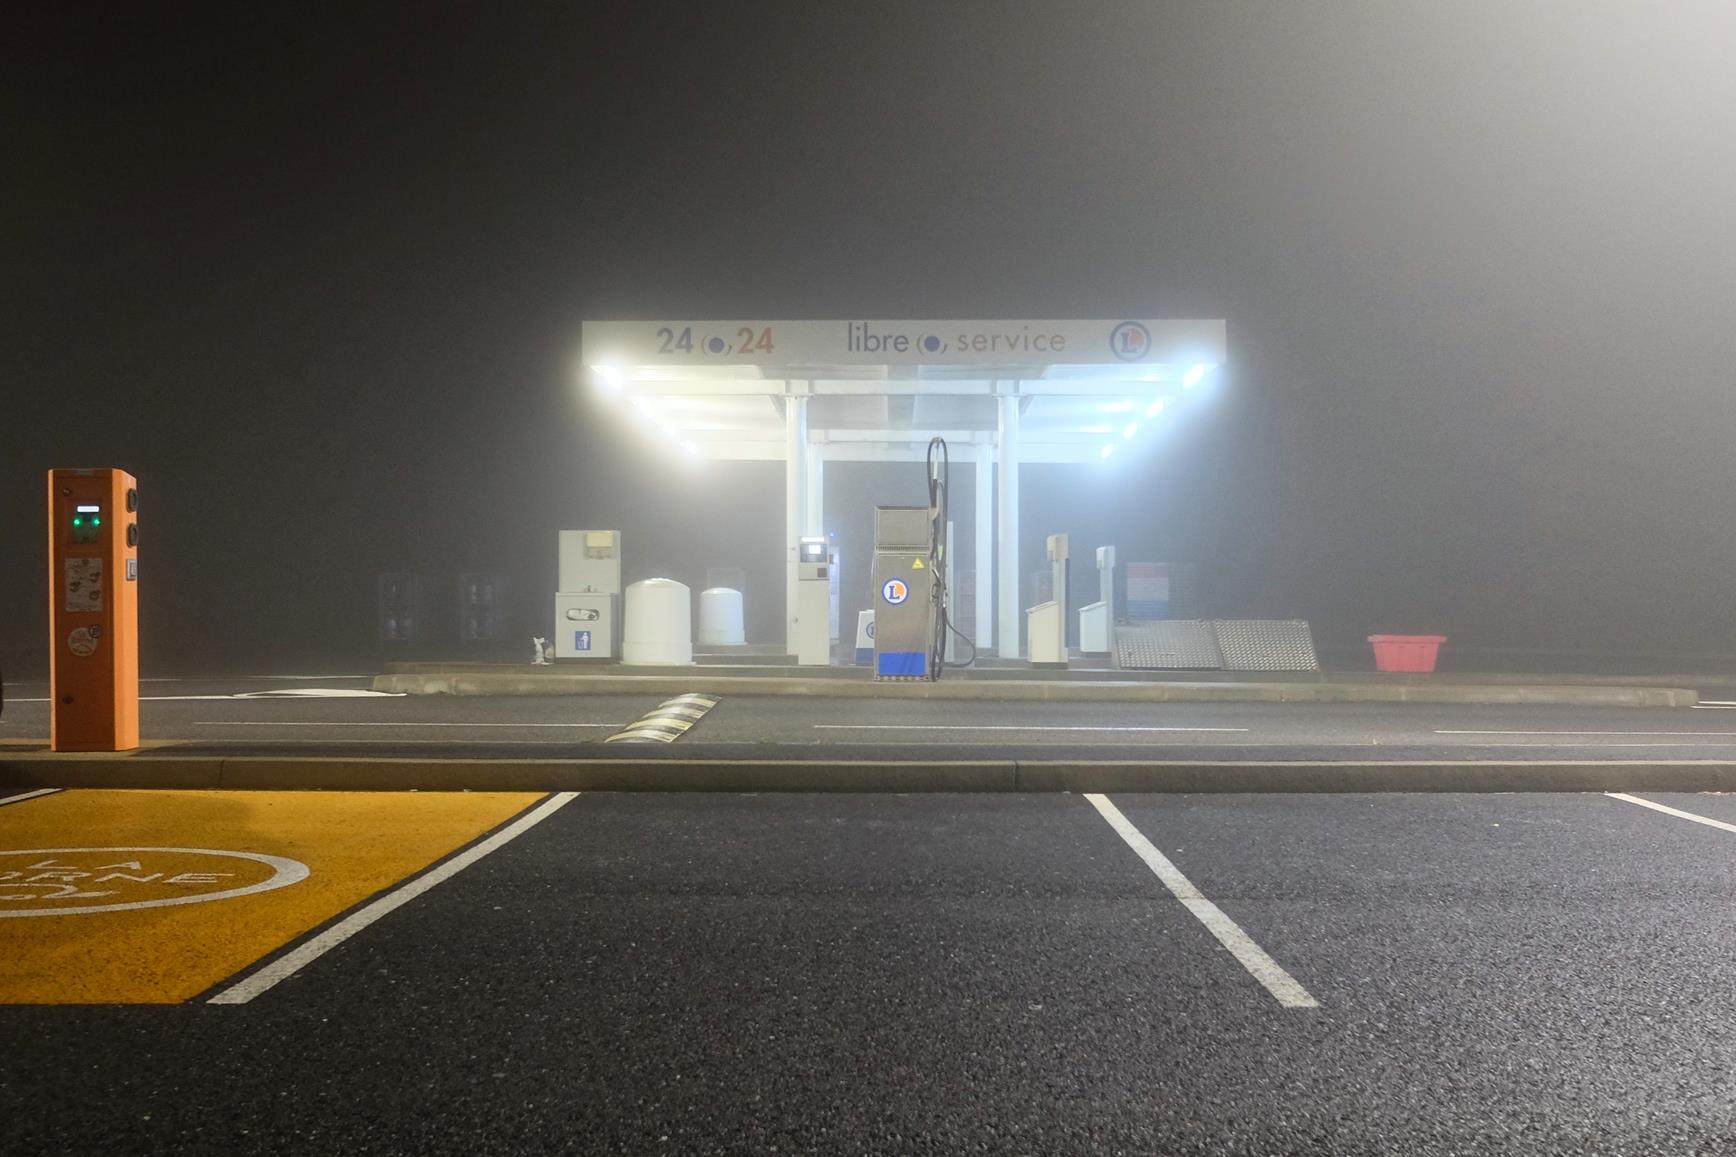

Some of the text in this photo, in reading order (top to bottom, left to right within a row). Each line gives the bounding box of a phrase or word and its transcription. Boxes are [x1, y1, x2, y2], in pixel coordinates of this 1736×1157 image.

[656, 327, 774, 354] 24 24
[848, 322, 1065, 352] libre service
[1121, 332, 1138, 353] L
[889, 585, 900, 600] L
